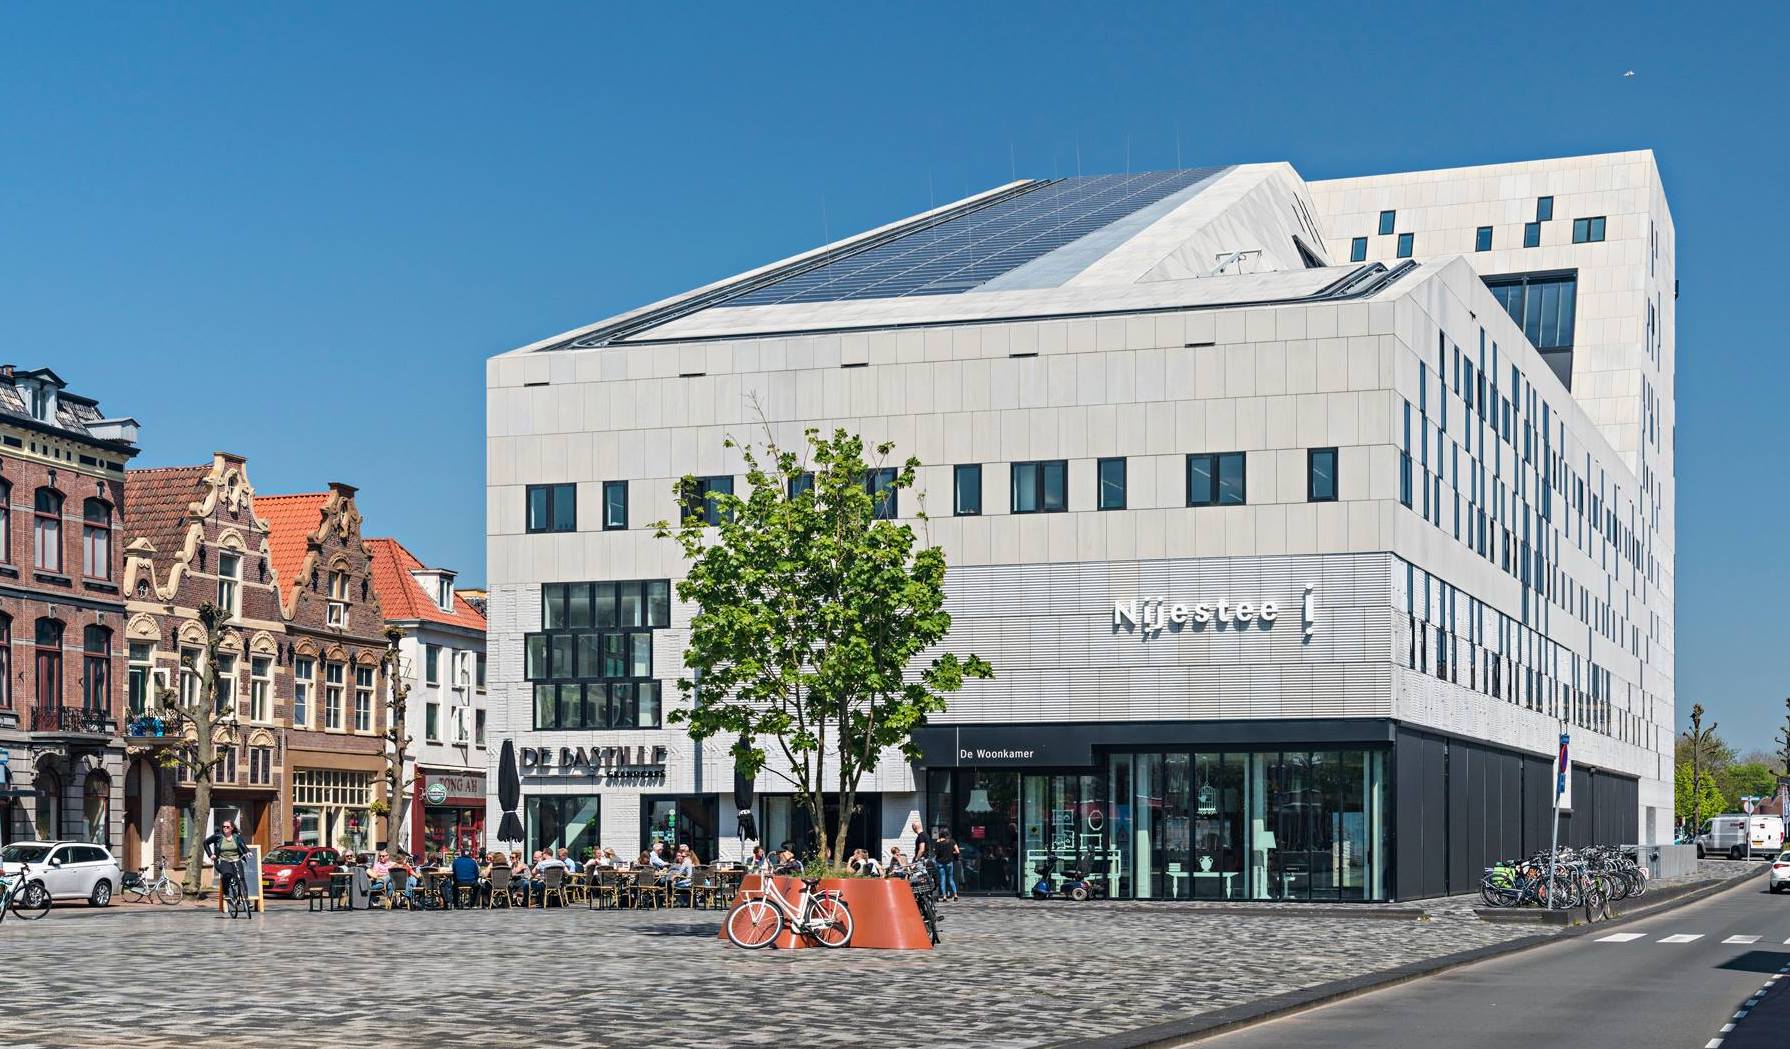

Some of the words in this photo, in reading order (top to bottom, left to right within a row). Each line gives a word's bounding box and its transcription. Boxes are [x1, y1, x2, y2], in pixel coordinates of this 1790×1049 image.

[1114, 596, 1279, 633] Nijestee
[520, 746, 551, 767] DE
[559, 745, 666, 768] BASTILLE
[960, 749, 973, 759] De
[977, 749, 1034, 759] Woonkamer
